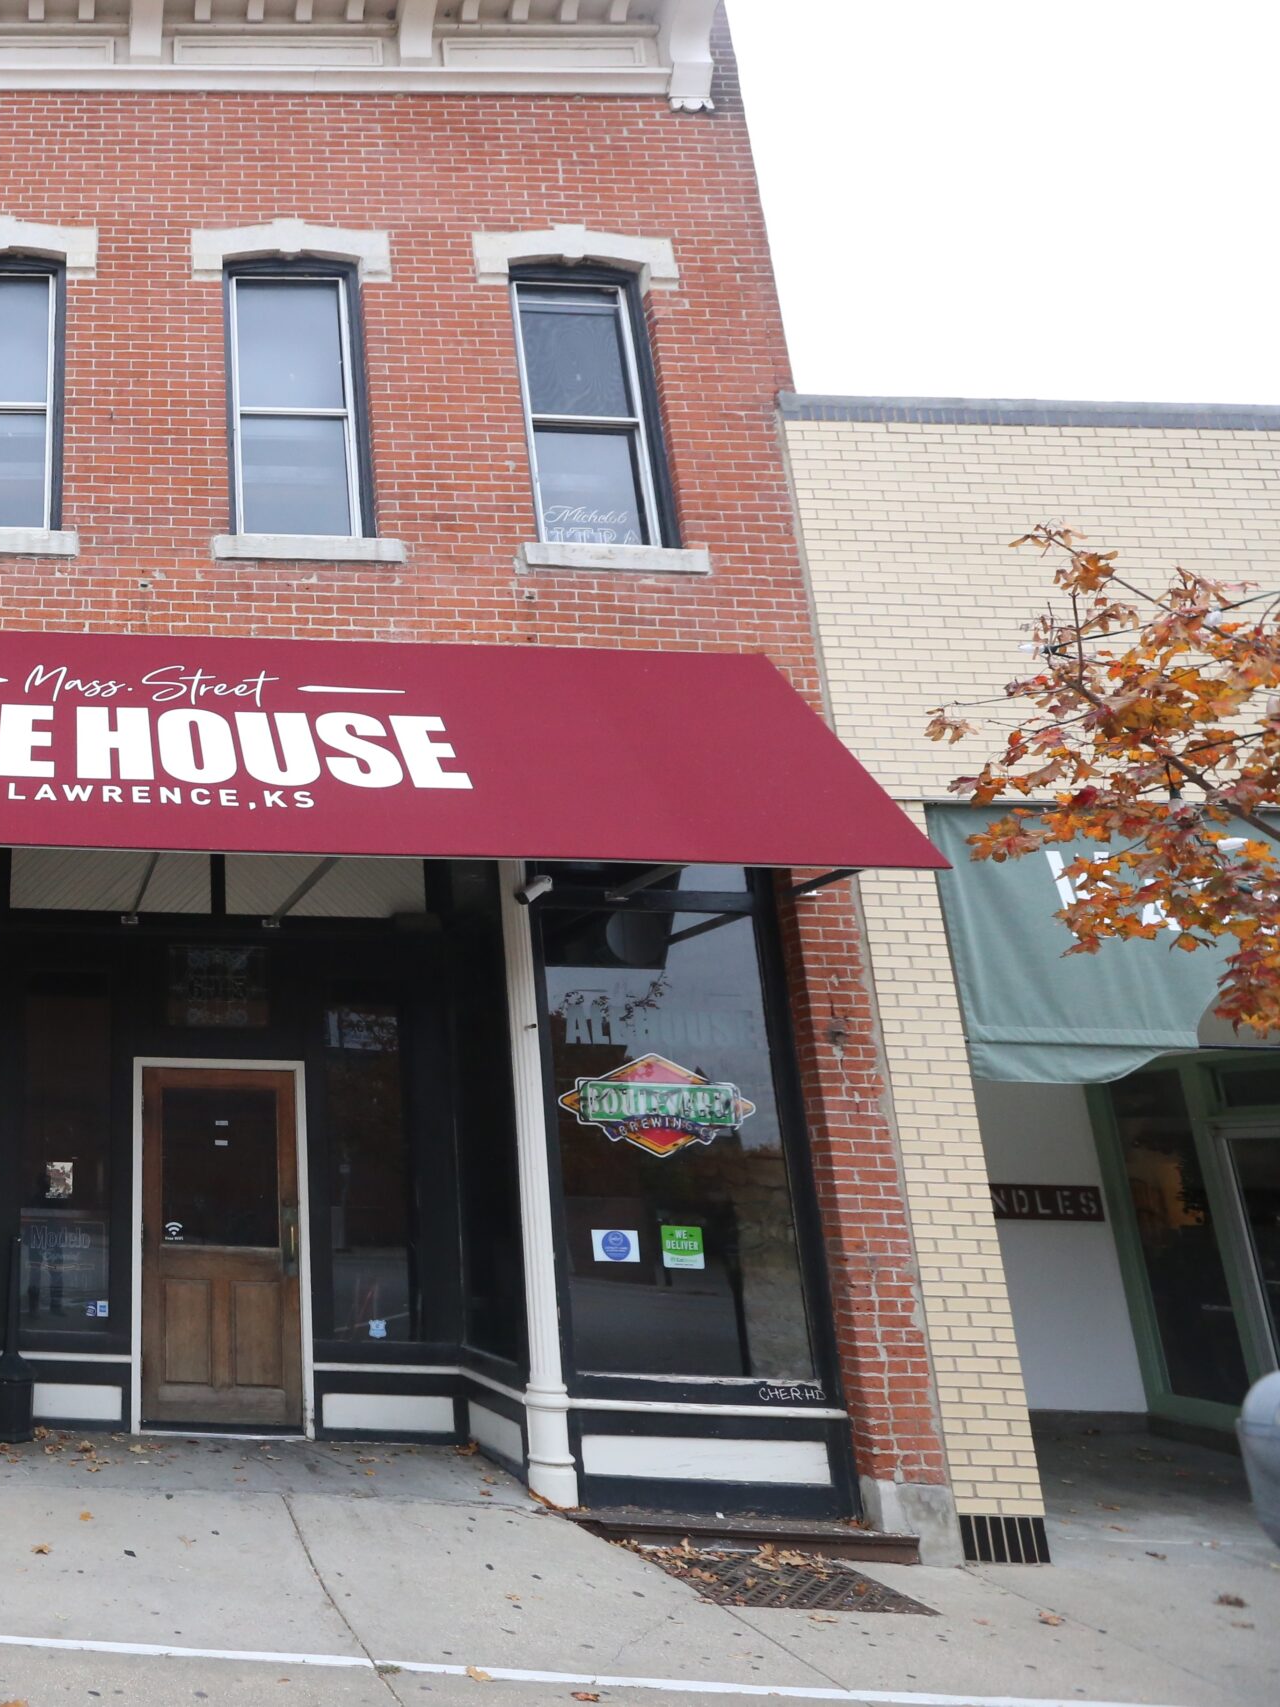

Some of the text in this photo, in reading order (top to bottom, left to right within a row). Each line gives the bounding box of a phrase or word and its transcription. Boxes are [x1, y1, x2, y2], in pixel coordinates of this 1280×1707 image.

[24, 663, 282, 707] Mass. Street
[618, 1116, 695, 1136] BREWING
[31, 1226, 90, 1248] Modelo
[674, 1229, 688, 1239] WE
[665, 1240, 699, 1251] DELIVER
